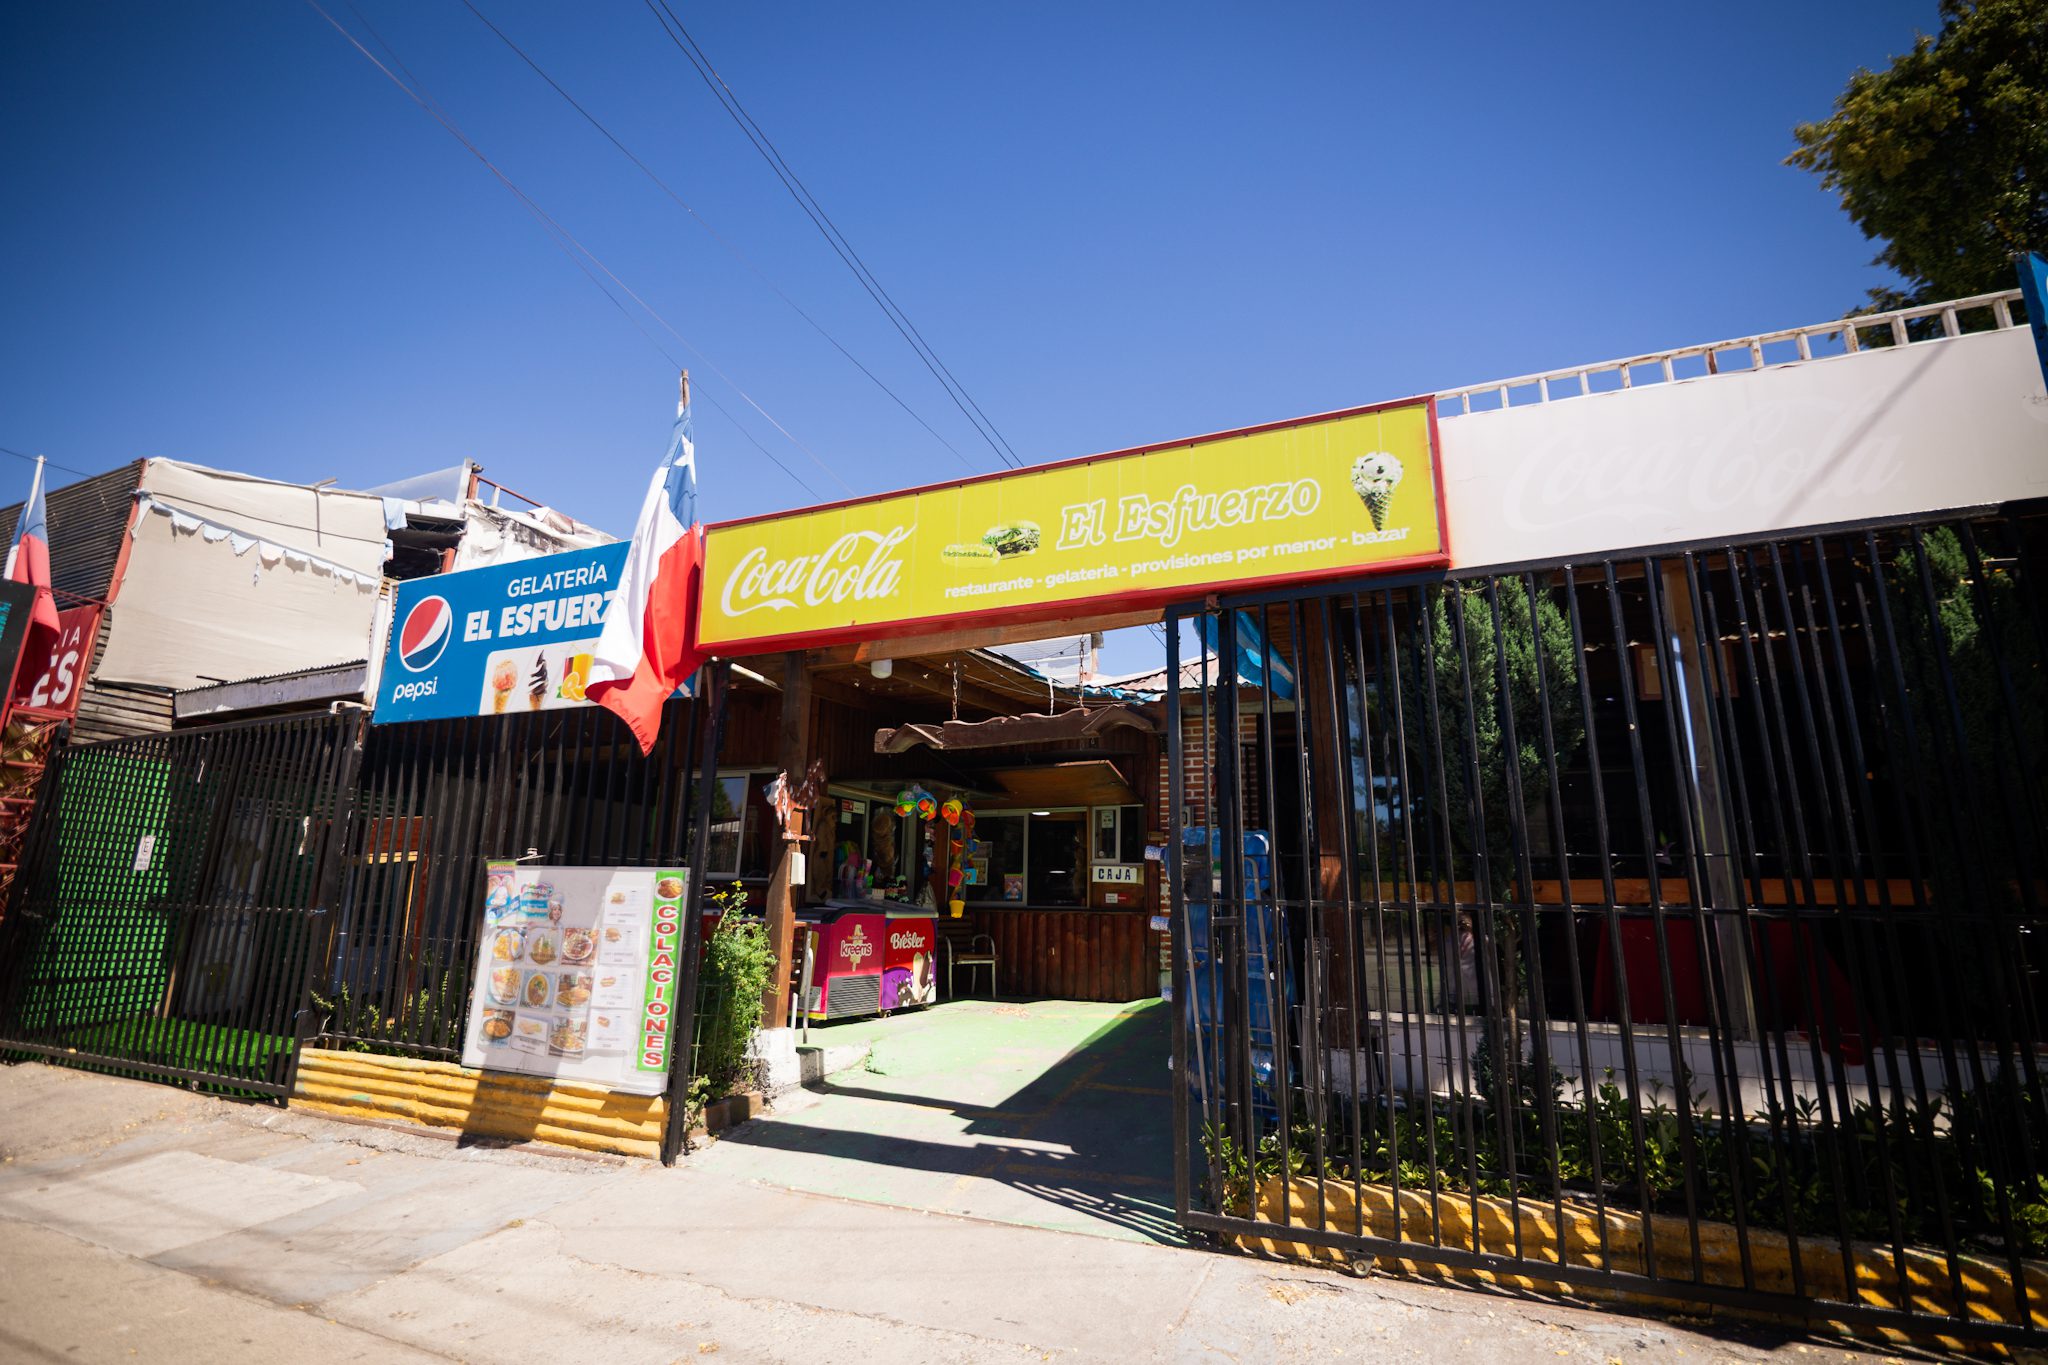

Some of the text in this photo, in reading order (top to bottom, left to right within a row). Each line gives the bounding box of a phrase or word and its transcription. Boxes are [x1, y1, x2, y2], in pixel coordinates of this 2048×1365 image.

[1056, 478, 1321, 551] El Esfuerzo
[507, 561, 608, 598] GELATERÍA
[721, 522, 918, 617] Coca-Cola
[945, 577, 1034, 599] restaurante
[1045, 564, 1118, 589] gelateria
[1130, 549, 1234, 578] provisiones
[1236, 544, 1270, 564] por
[1273, 535, 1337, 557] menor
[1351, 526, 1411, 546] bazar
[463, 610, 492, 642] EL
[392, 677, 438, 704] pepsi
[1098, 868, 1131, 880] CAJA
[840, 940, 872, 957] kreems
[890, 931, 926, 949] Bresler
[643, 905, 678, 1067] COLACIONES
